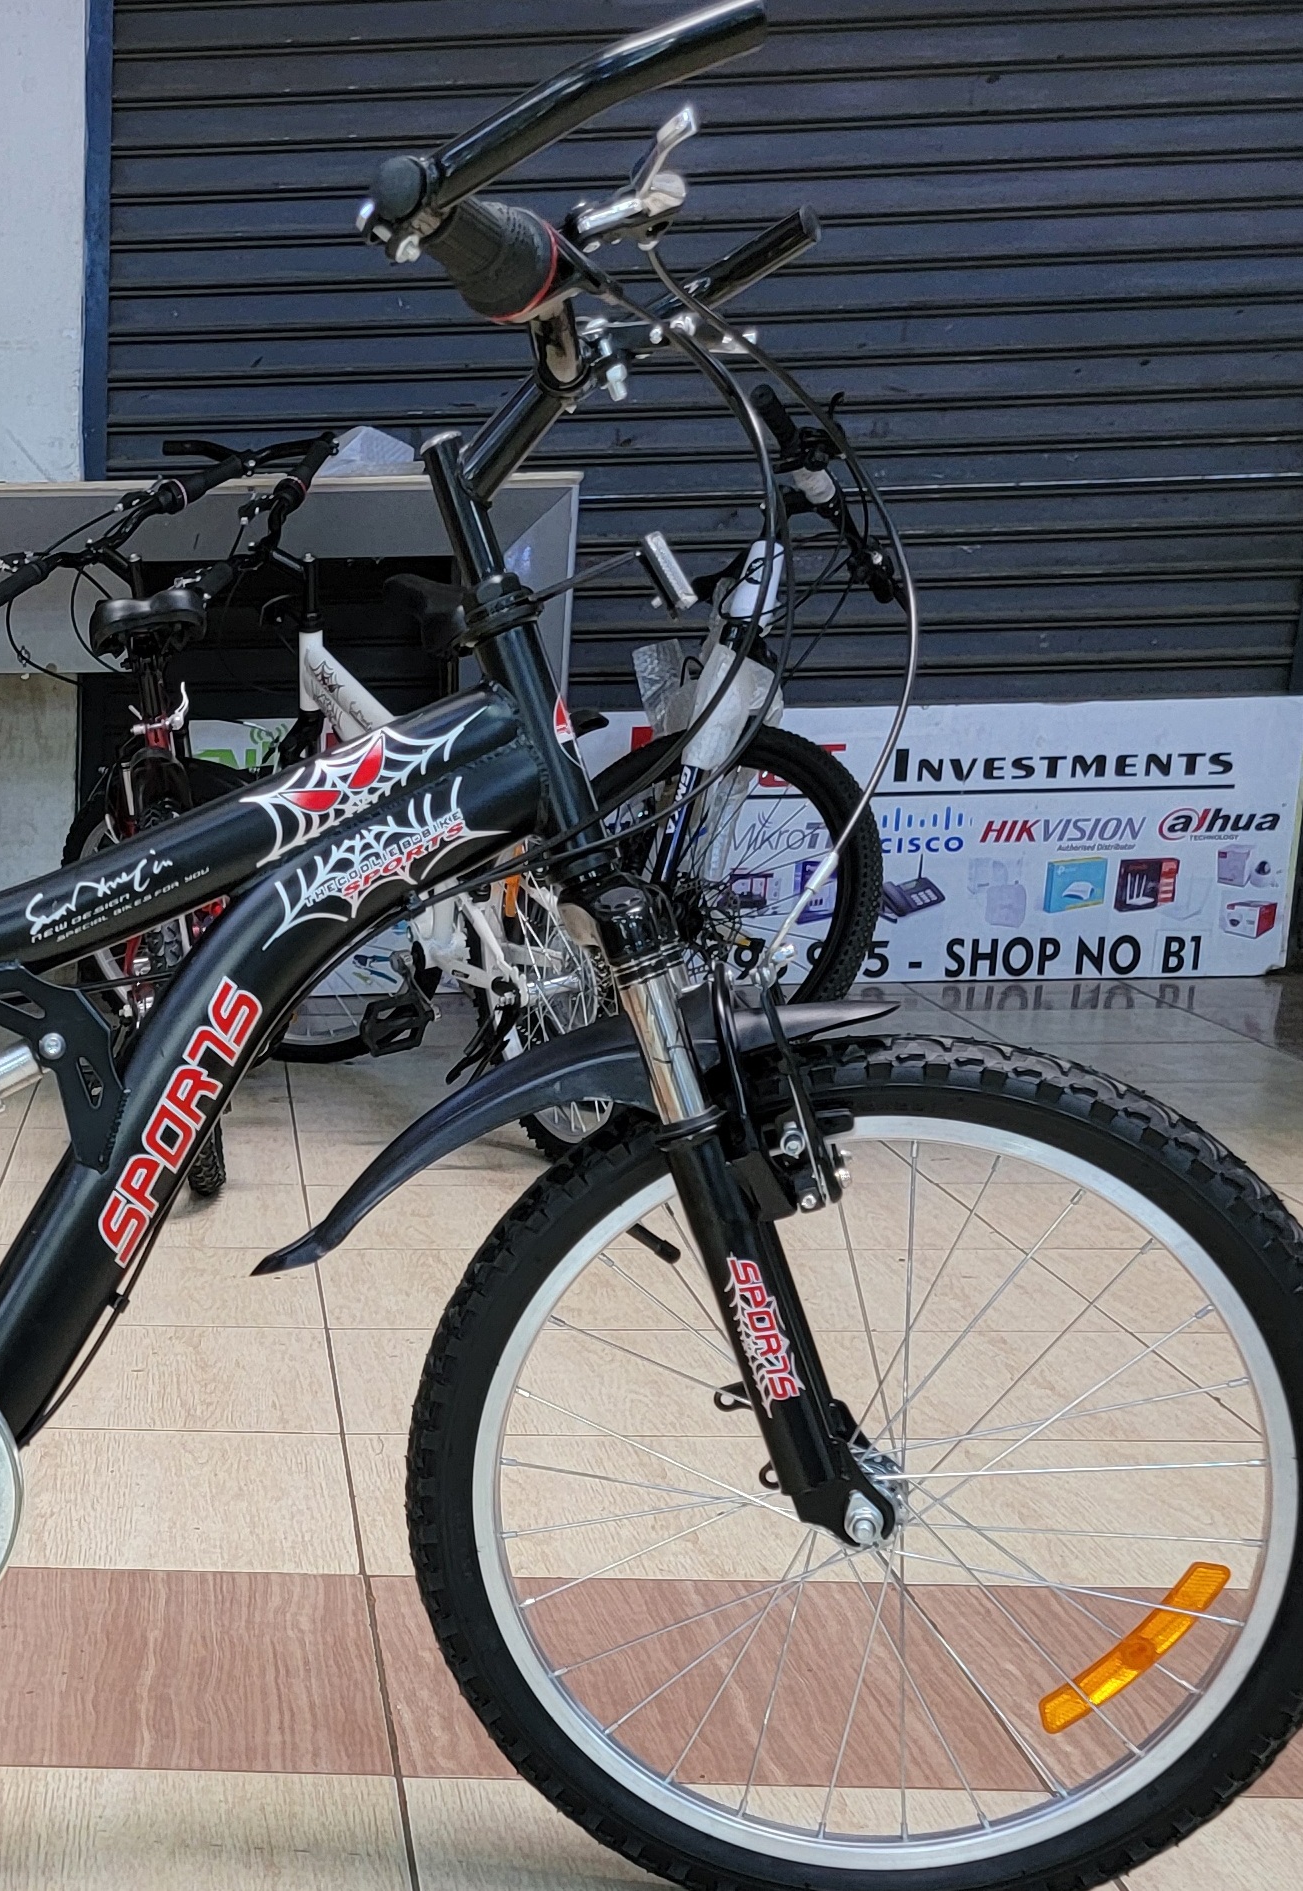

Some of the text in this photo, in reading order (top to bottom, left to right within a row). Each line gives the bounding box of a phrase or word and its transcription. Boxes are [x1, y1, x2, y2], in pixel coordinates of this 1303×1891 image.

[893, 748, 1235, 784] INVESTMENTS
[979, 816, 1147, 844] HIKVISION
[1189, 834, 1239, 842] TECHNOLOGY
[341, 819, 465, 899] SPORTS
[944, 936, 1062, 978] SHOP
[1074, 934, 1142, 977] NO
[1161, 935, 1203, 974] B1
[98, 976, 263, 1268] SPORTS
[726, 1257, 801, 1400] SPORTS
